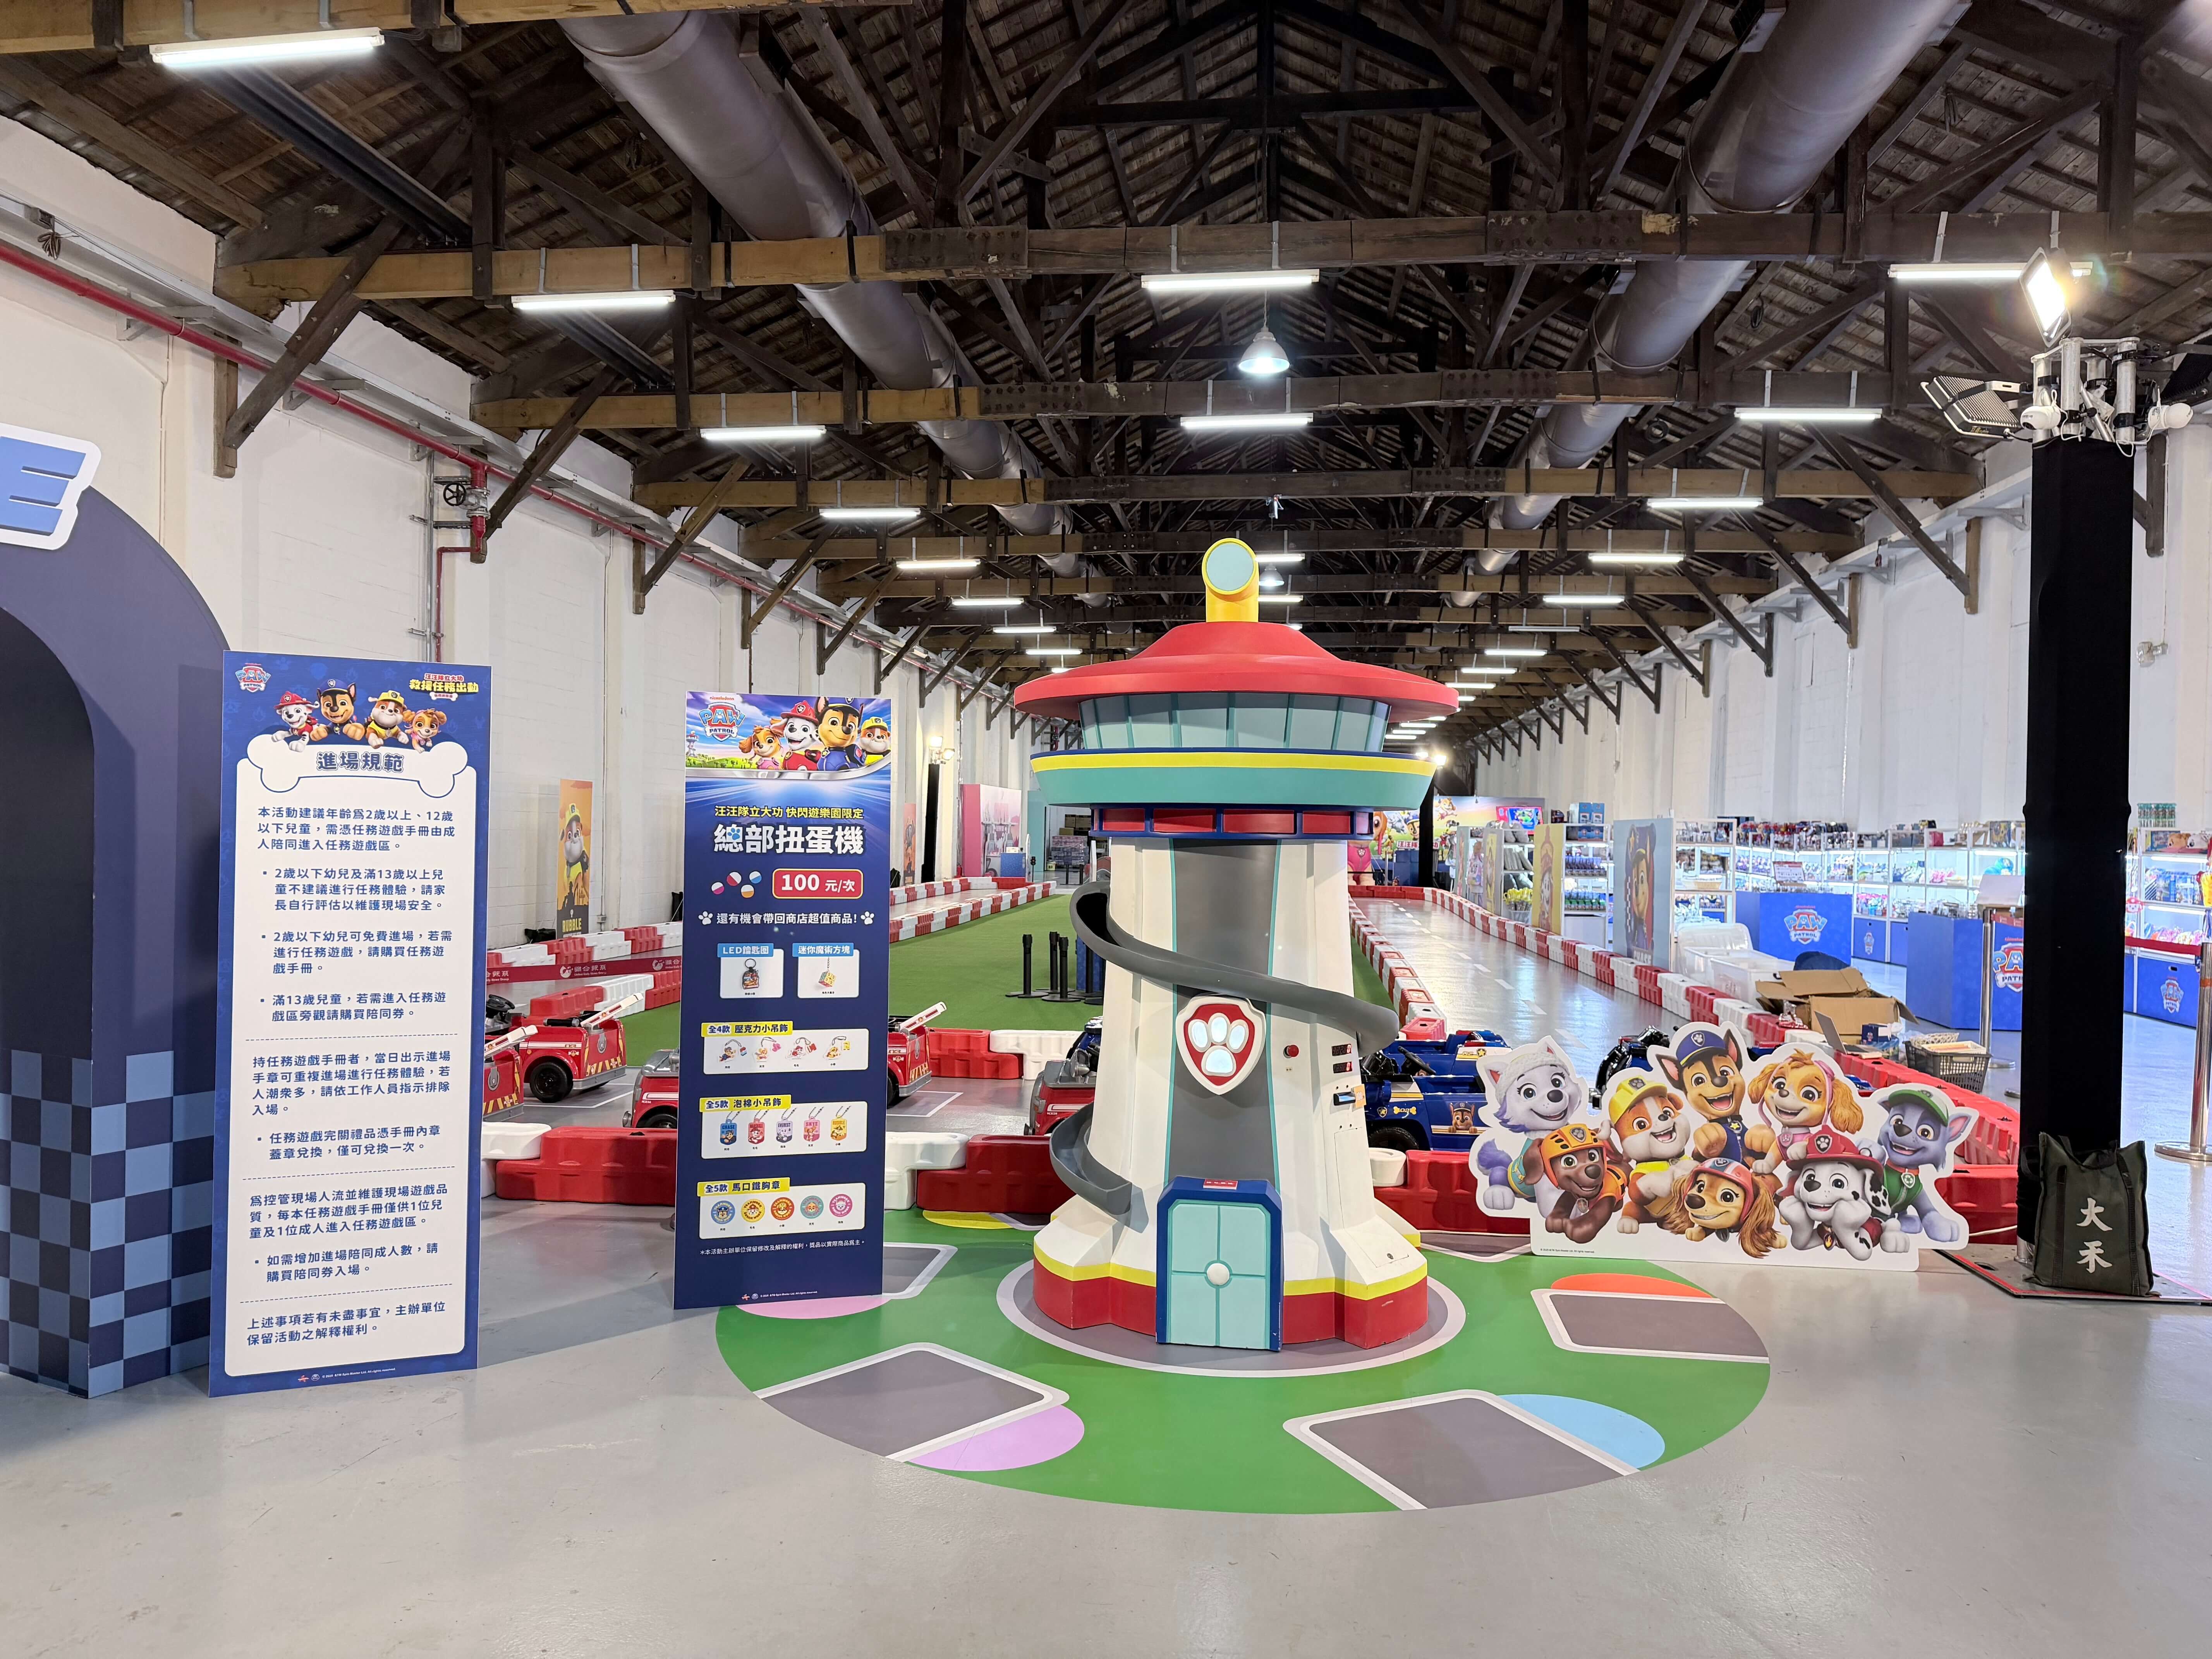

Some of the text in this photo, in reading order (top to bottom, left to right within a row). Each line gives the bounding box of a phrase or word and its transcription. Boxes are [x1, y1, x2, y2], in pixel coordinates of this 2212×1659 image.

[235, 670, 271, 683] PAW
[409, 679, 479, 693] 救援任務出動
[697, 707, 746, 728] PAW
[316, 752, 404, 773] 進場規範
[715, 805, 864, 819] 汪汪隊立大功 快閃遊樂園限定
[258, 823, 455, 837] 以下兒童，需憑任務遊戲手冊由成
[258, 839, 401, 851] 人陪同進入任務遊戲區。
[713, 824, 864, 854] 總部扭蛋機
[275, 868, 443, 880] 2歲以下幼兒及滿13歲以上兒
[275, 884, 445, 895] 童不建議進行任務體驗，請家
[781, 874, 855, 893] 100 元/次
[275, 900, 442, 911] 長自行評估以維護現場安全。
[716, 912, 857, 924] 還有機會帶回商店超值商品!
[1784, 915, 1827, 931] PAW
[562, 918, 581, 933] RUBBLE
[273, 930, 452, 942] 2歲以下幼兒可免費進場，若需
[273, 946, 444, 958] 進行任務遊戲，請購買任務遊
[723, 946, 769, 955] LED鑰匙圈
[798, 945, 850, 955] 迷你魔術方塊
[273, 963, 323, 974] 戲手冊。
[1993, 951, 2023, 973] PA
[272, 992, 447, 1006] 滿13歲兒童，若需進入任務遊
[272, 1008, 414, 1022] 戲區旁觀請購買陪同券。
[708, 1024, 788, 1034] 全4款 壓克力小吊飾
[1346, 1044, 1351, 1053] 0
[252, 1051, 450, 1068] 持任務遊戲手冊者，當日出示進場
[1346, 1062, 1350, 1071] 0
[252, 1066, 450, 1084] 手章可重複進場進行任務體驗，若
[252, 1104, 289, 1115] 入場。
[706, 1098, 781, 1109] 全5款 泡棉小吊飾
[270, 1125, 441, 1144] 任務遊戲完關禮品憑手冊內章
[705, 1181, 780, 1193] 全5款 馬口鐵胸章
[249, 1199, 443, 1223] 質，每本任務遊戲手冊僅供1位兒
[249, 1216, 426, 1239] 童及1位成人進入任務遊戲區。
[2076, 1197, 2113, 1273] 大禾
[267, 1242, 438, 1267] 如需增加進場陪同成人數，請
[266, 1264, 370, 1283] 購買陪同券入場。
[247, 1301, 446, 1329] 上述事項若有未盡事宜，主辦單位
[247, 1323, 378, 1346] 保留活動之解釋權利。
